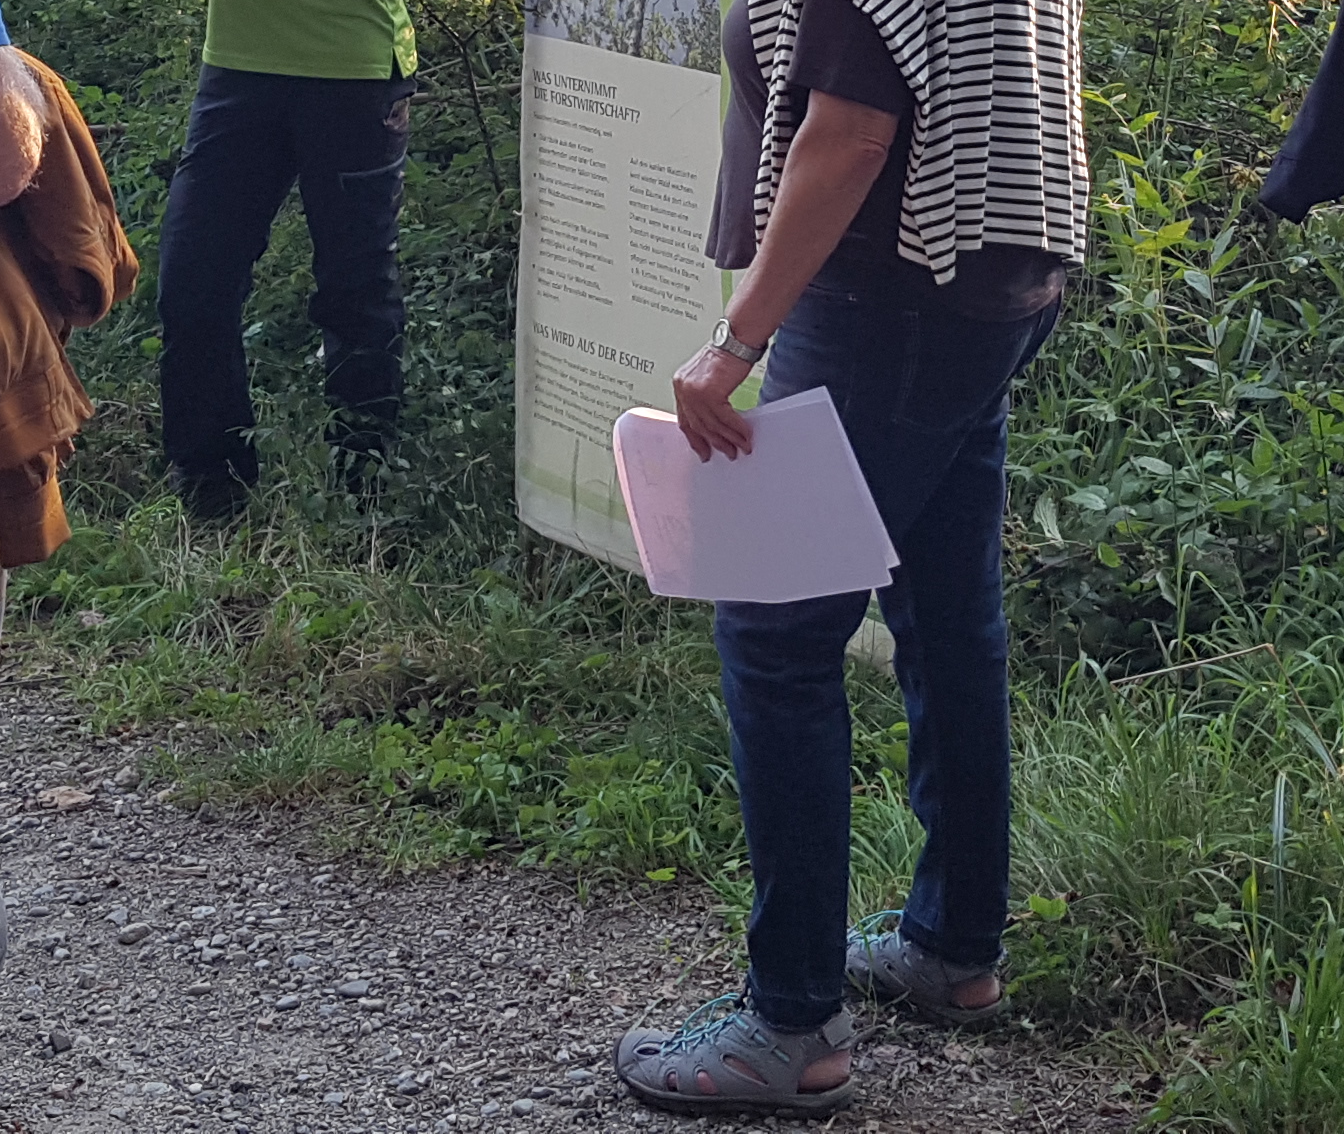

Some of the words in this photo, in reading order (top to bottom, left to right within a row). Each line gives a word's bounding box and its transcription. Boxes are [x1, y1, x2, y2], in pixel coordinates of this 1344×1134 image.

[532, 68, 552, 85] WAS
[554, 73, 618, 100] UNTERNIMMT
[533, 85, 549, 102] DIE
[550, 90, 641, 124] FORSTWIRTSCHAFT?
[532, 322, 549, 339] WAS
[551, 327, 575, 348] WIRD
[577, 337, 596, 355] AUS
[598, 344, 617, 363] DER
[619, 351, 655, 375] ESCHE?
